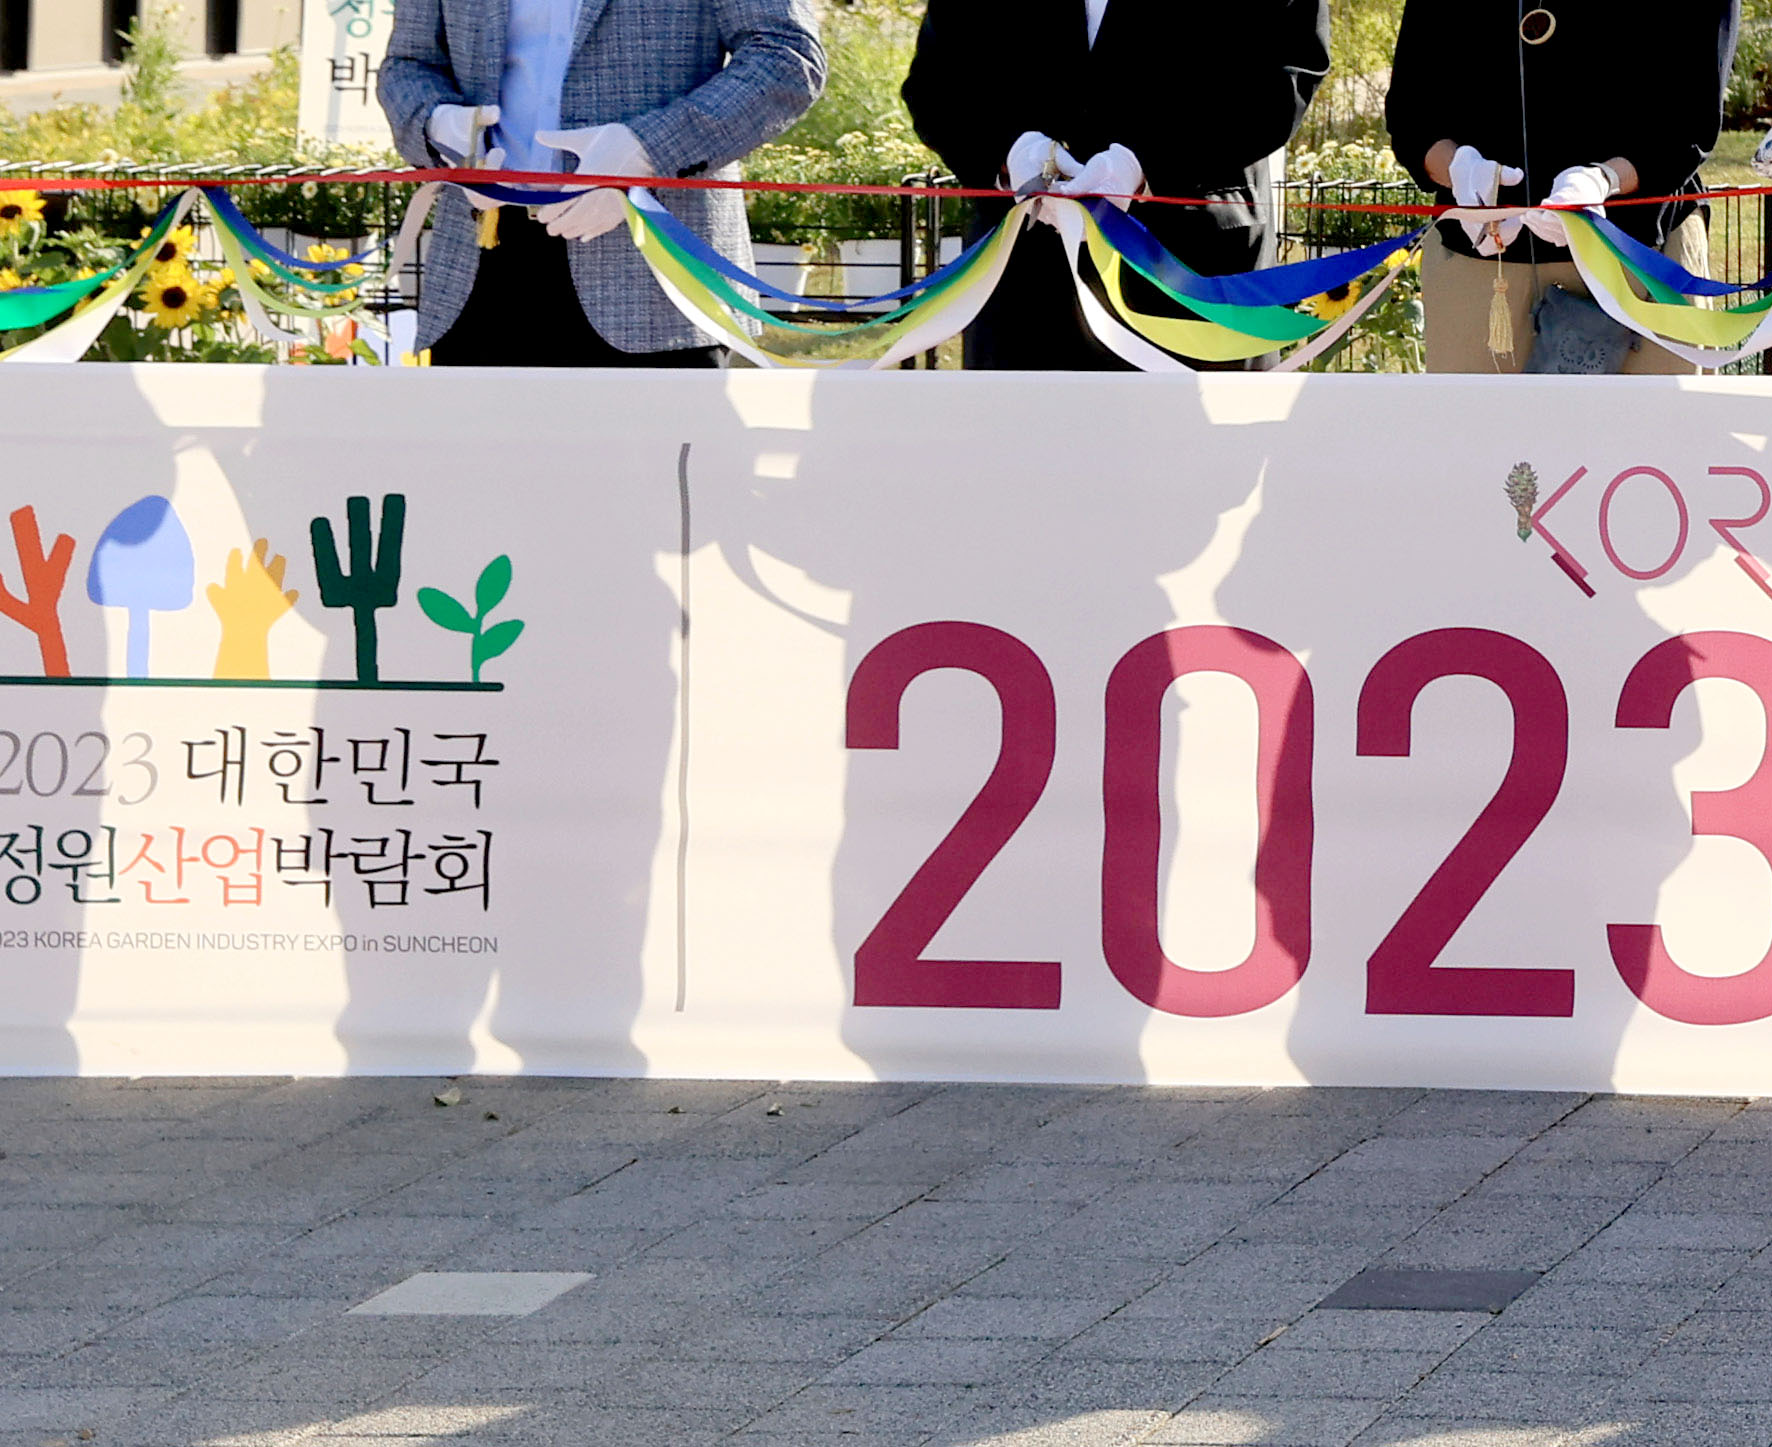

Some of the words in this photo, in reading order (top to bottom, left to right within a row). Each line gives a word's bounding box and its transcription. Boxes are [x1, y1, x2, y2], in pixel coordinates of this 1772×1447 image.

[180, 725, 500, 810] 대한민국
[0, 824, 494, 913] 정원산업박람회
[34, 931, 101, 950] KOREA
[107, 931, 191, 950] GARDEN
[196, 932, 299, 952] INDUSTRY
[304, 934, 358, 952] EXPO
[363, 935, 378, 952] in
[383, 935, 499, 954] SUNCHEON
